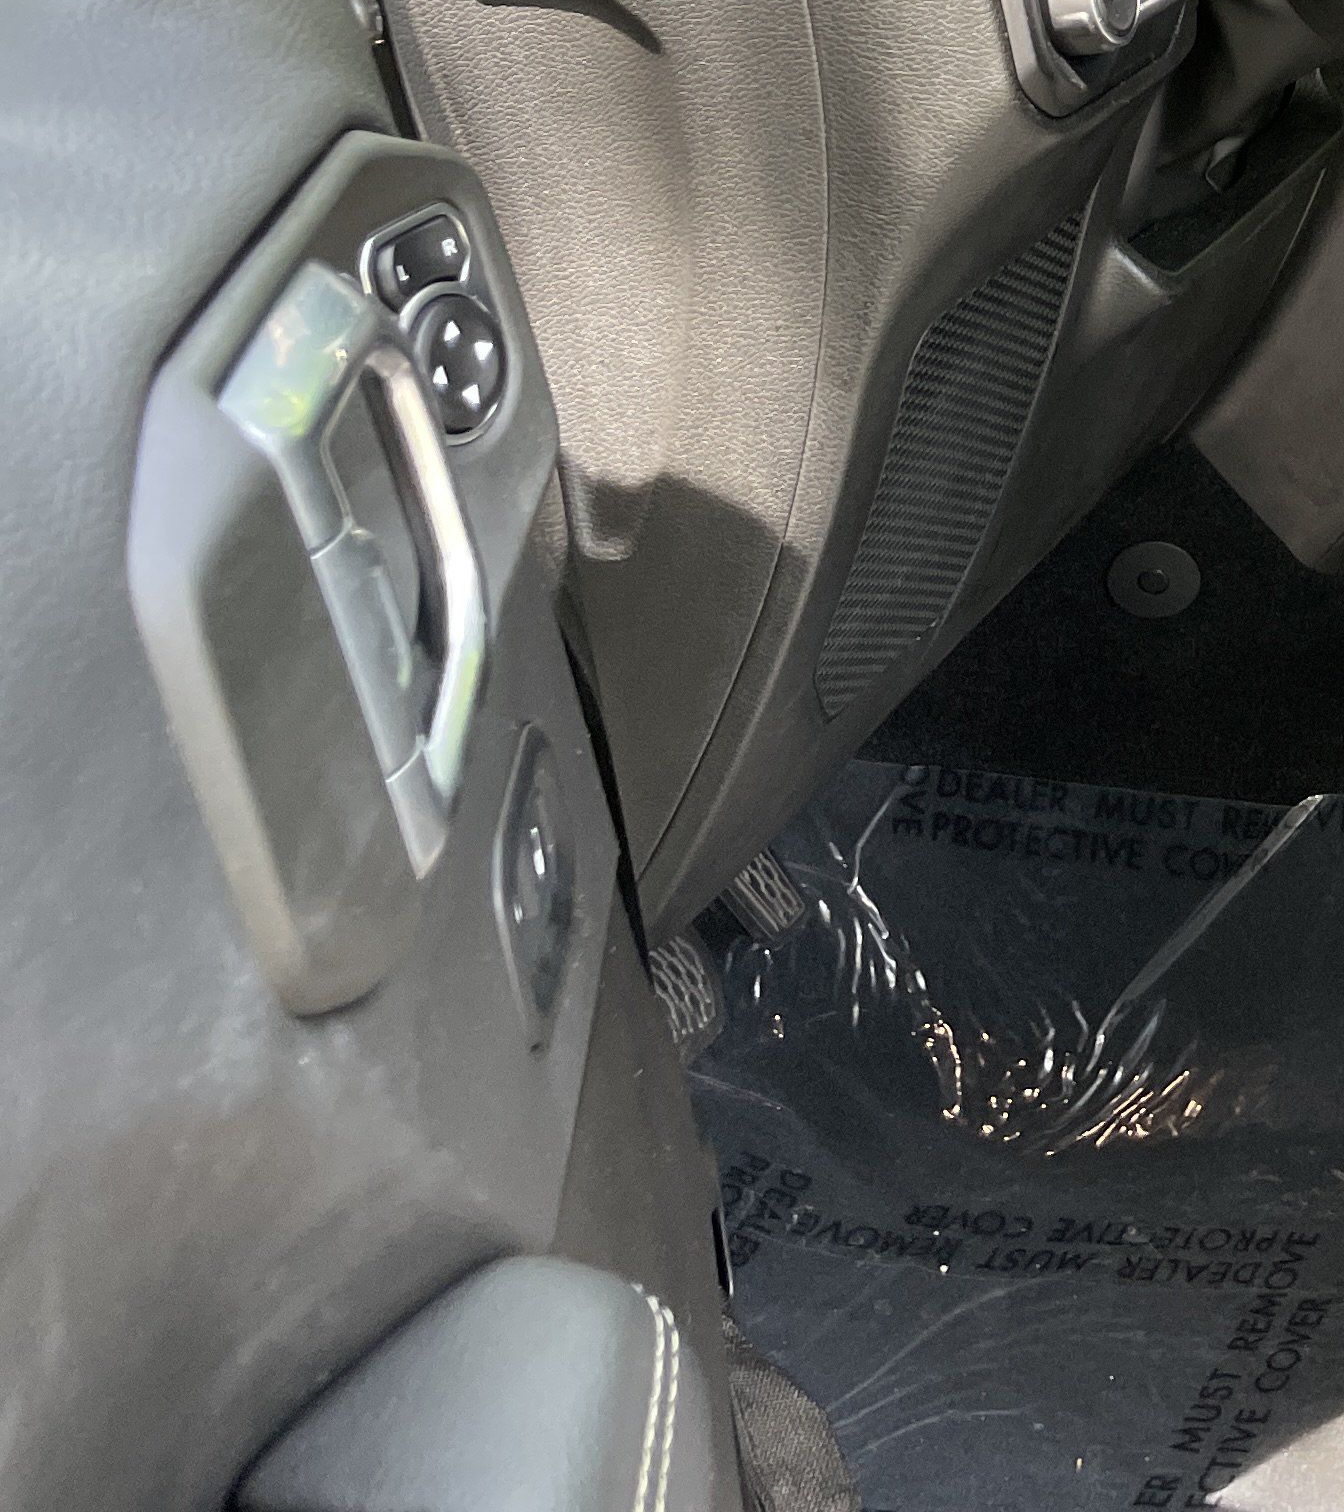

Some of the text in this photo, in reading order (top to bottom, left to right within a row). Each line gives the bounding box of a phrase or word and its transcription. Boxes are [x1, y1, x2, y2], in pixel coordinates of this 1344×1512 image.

[396, 264, 410, 282] L
[442, 238, 458, 257] R
[936, 768, 1070, 813] DEALER
[1094, 788, 1201, 831] MUST
[930, 810, 1146, 872] PROTECTIVE
[788, 1207, 1263, 1288] DEALER MUST REMOVE
[903, 1203, 1034, 1243] COVER
[1169, 1367, 1242, 1455] MUST
[1227, 1229, 1322, 1352] REMOVE
[1253, 1296, 1334, 1394] COVER
